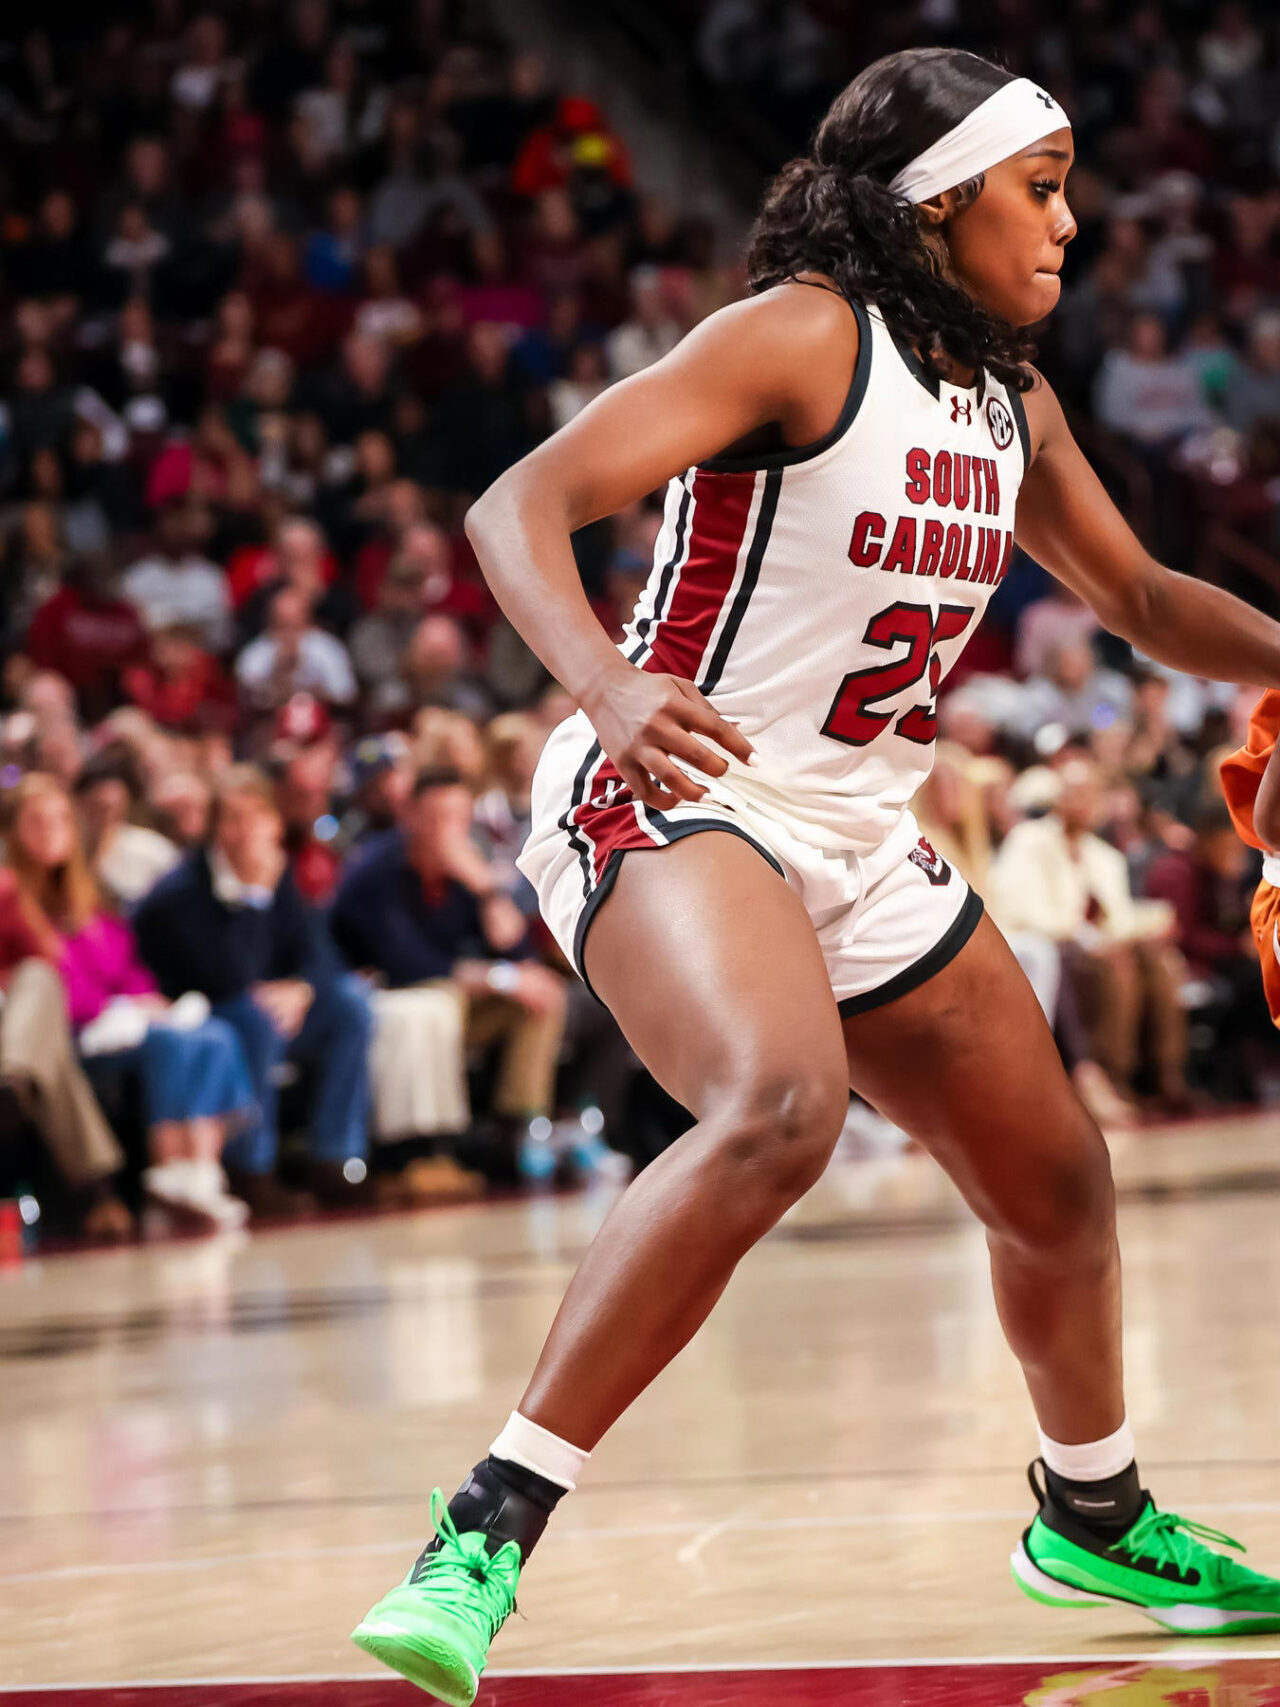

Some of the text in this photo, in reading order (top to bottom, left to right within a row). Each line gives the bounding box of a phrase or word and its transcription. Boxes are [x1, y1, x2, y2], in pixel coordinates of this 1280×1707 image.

[987, 399, 1013, 448] SEC
[906, 448, 1000, 516] SOUTH
[820, 601, 975, 746] 25
